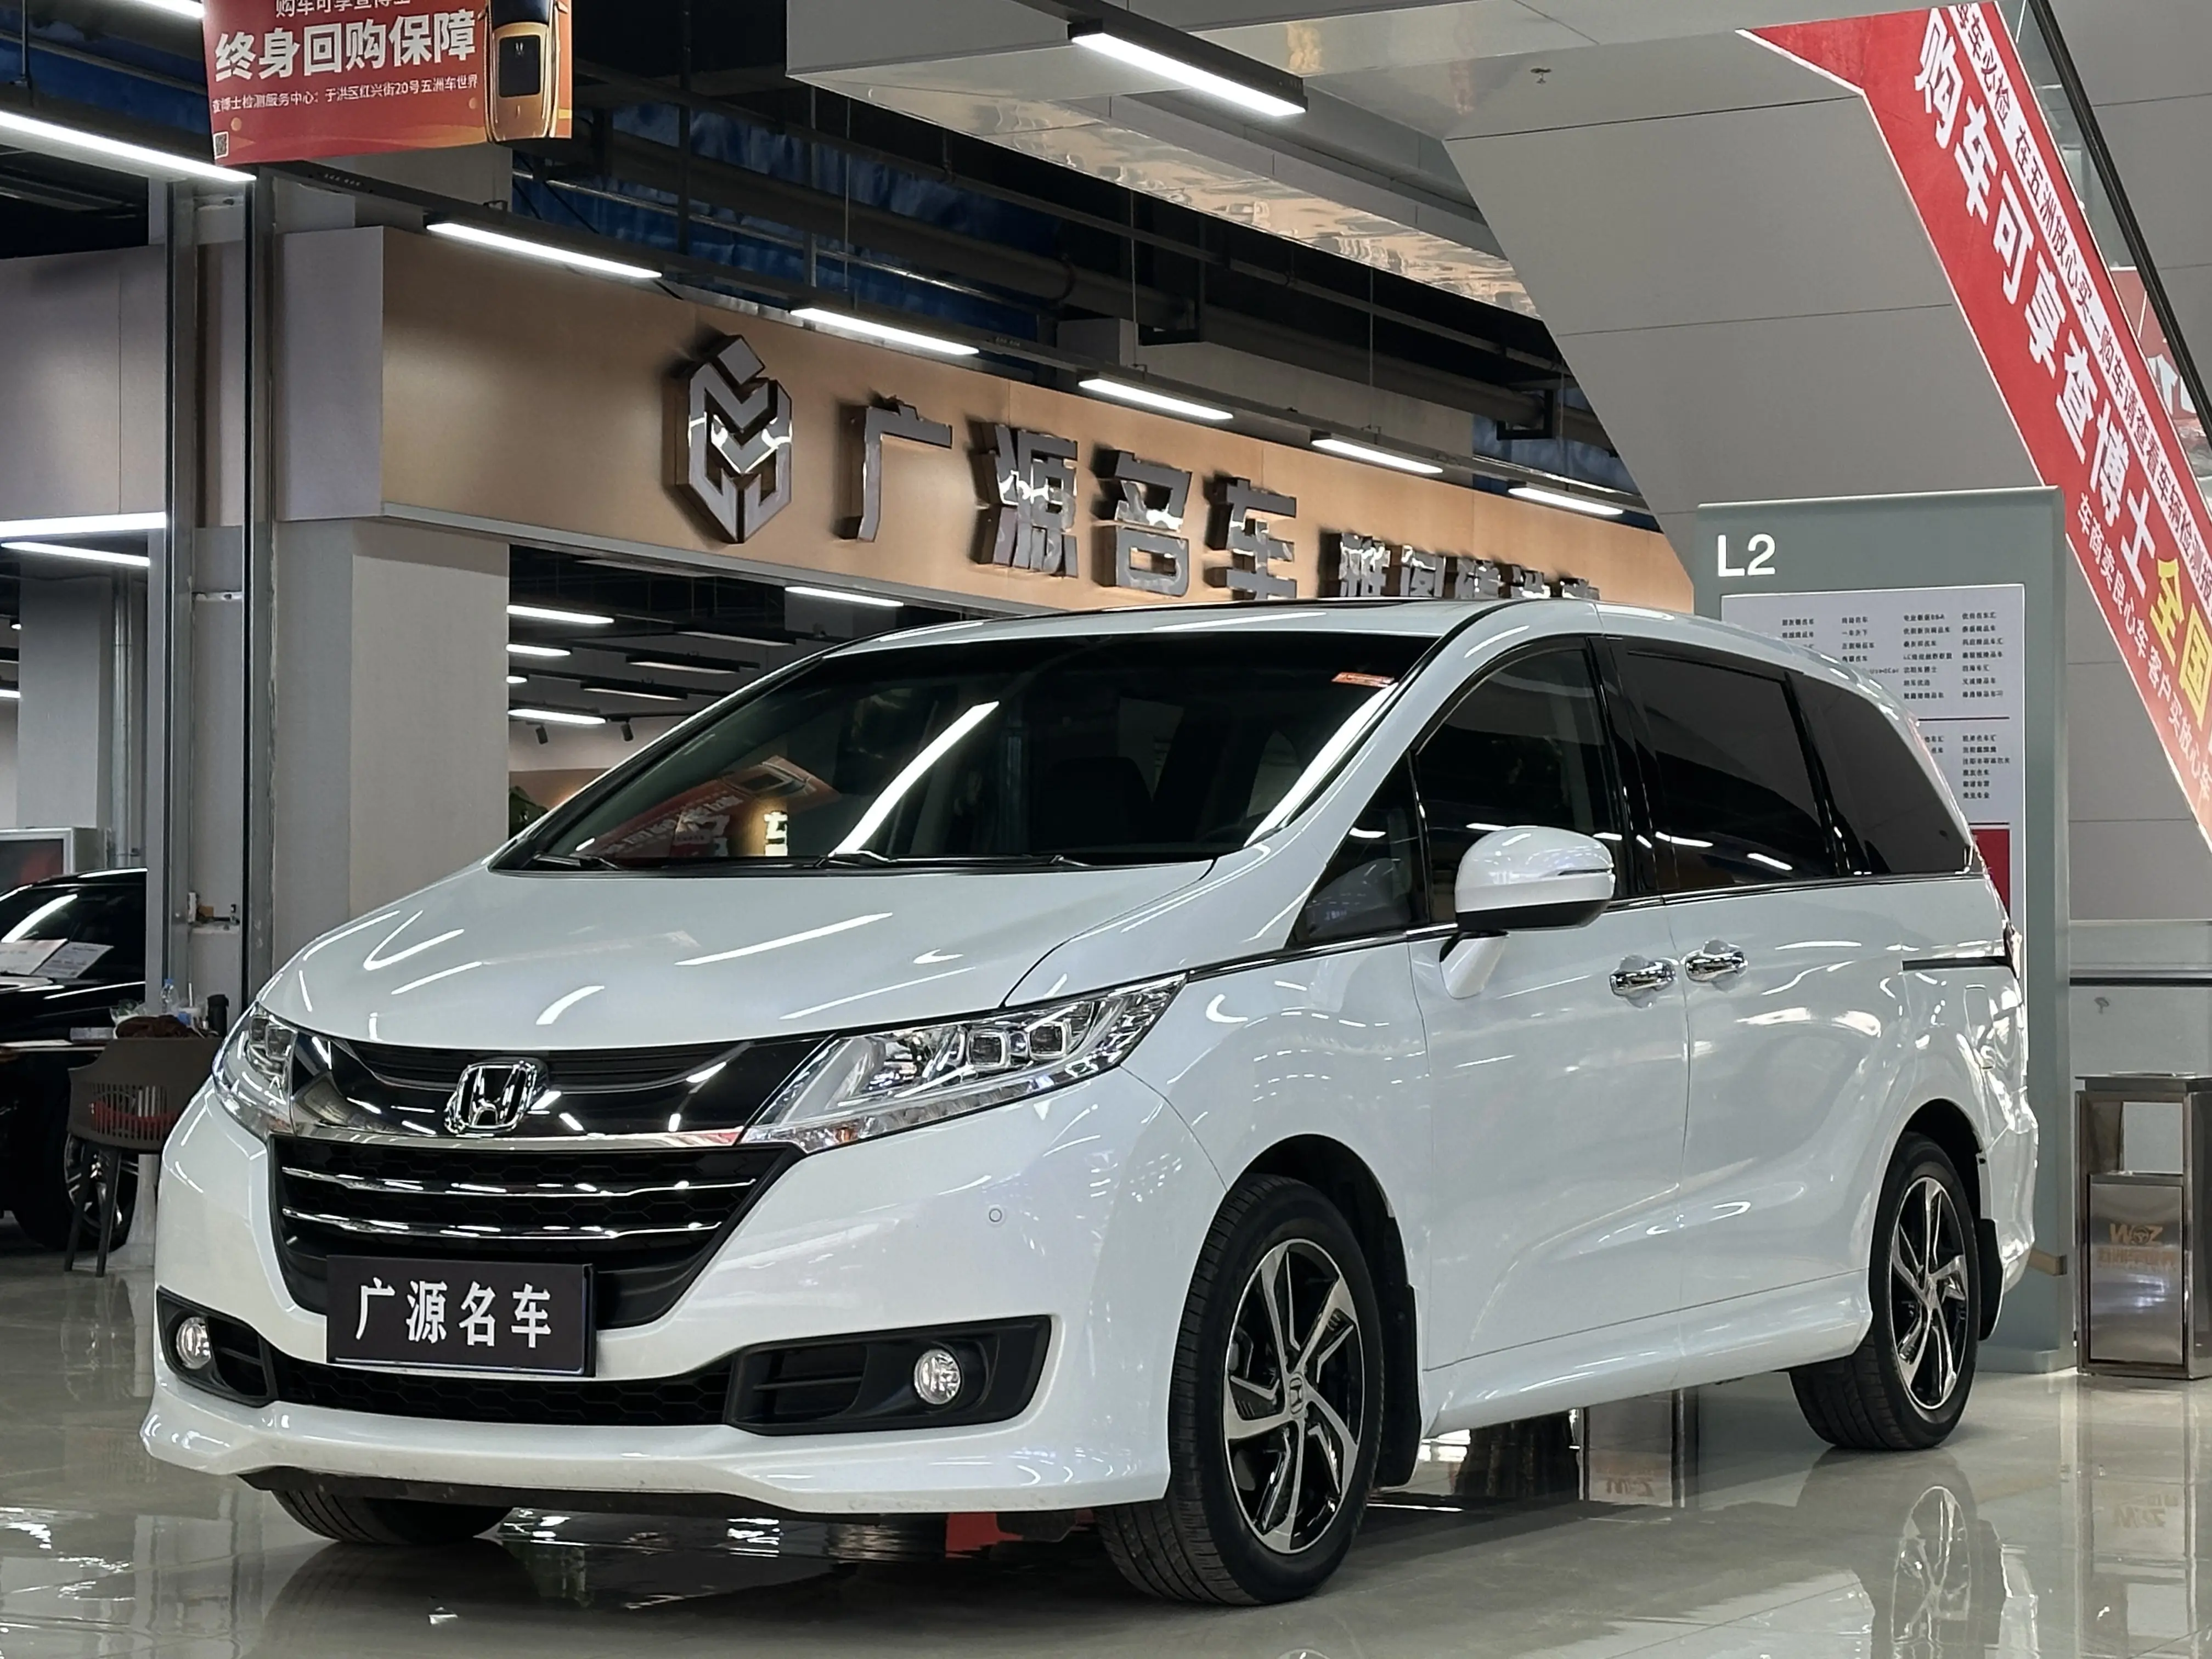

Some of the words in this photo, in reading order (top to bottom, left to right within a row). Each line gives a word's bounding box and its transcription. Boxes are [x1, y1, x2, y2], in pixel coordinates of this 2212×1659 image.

[215, 8, 476, 82] 终身回购保障
[1915, 7, 2212, 756] 购车可享查博士全国
[856, 403, 1297, 600] 广源名车
[1717, 533, 1776, 577] L2
[356, 1277, 551, 1348] 广源名车
